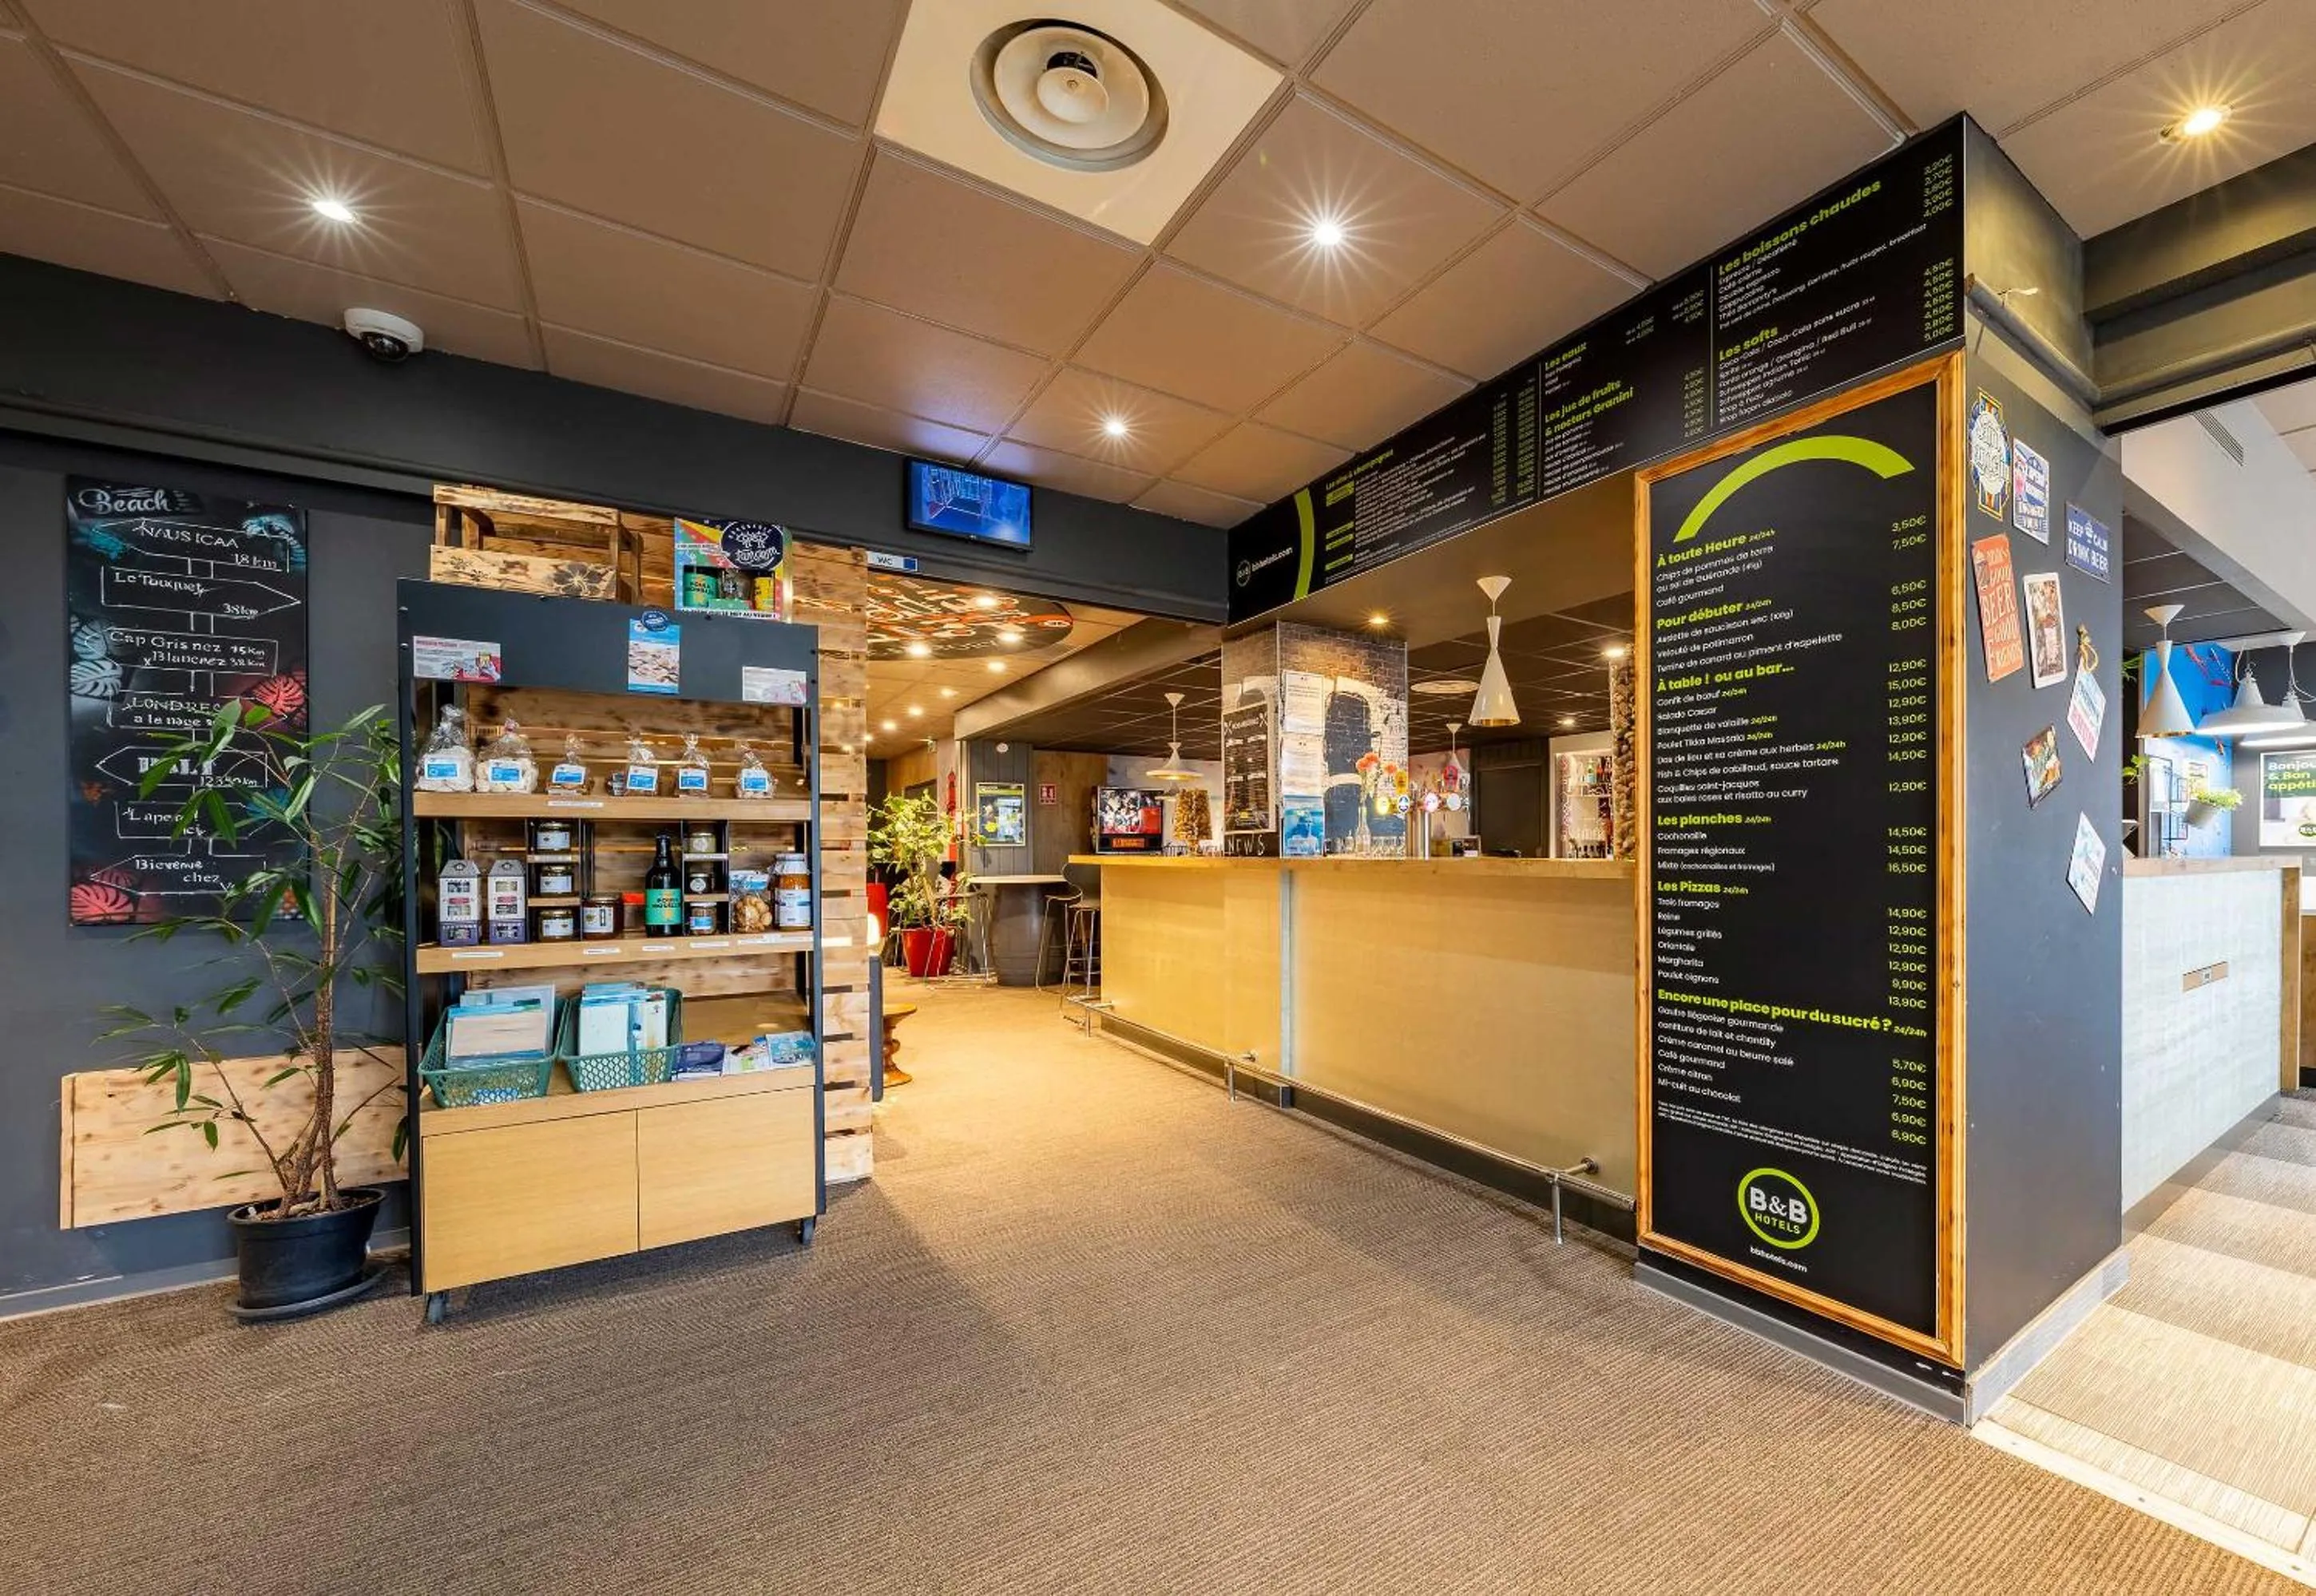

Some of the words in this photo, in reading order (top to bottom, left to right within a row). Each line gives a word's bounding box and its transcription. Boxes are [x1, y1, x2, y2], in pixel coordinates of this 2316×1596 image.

[1719, 257, 1740, 276] Les
[1743, 222, 1807, 263] boissons
[1810, 180, 1882, 226] chaudes
[1719, 343, 1740, 361] Les
[1743, 326, 1779, 350] softs
[1592, 386, 1634, 414] Granini
[78, 488, 173, 513] Beach
[2068, 518, 2084, 538] KEEP
[877, 554, 893, 566] WC
[2068, 537, 2090, 564] DRINK
[2091, 549, 2109, 573] BEER
[114, 571, 138, 584] Le
[1656, 615, 1687, 630] Pour
[1688, 603, 1743, 623] débuter
[1982, 582, 2017, 629] BEER
[110, 631, 146, 647] Cap
[150, 636, 188, 650] Gris
[192, 642, 221, 653] nez
[2282, 770, 2310, 781] Bon
[1657, 815, 1678, 826] Les
[1679, 813, 1743, 828] planches
[1657, 881, 1678, 892] Les
[1679, 881, 1721, 893] Pizzas
[1658, 988, 1702, 1004] Encore
[1702, 996, 1729, 1008] une
[1729, 999, 1771, 1015] place
[1771, 1005, 1808, 1020] pour
[1809, 1009, 1830, 1023] du
[1832, 1015, 1881, 1030] sucré
[1755, 1212, 1801, 1234] HOTELS
